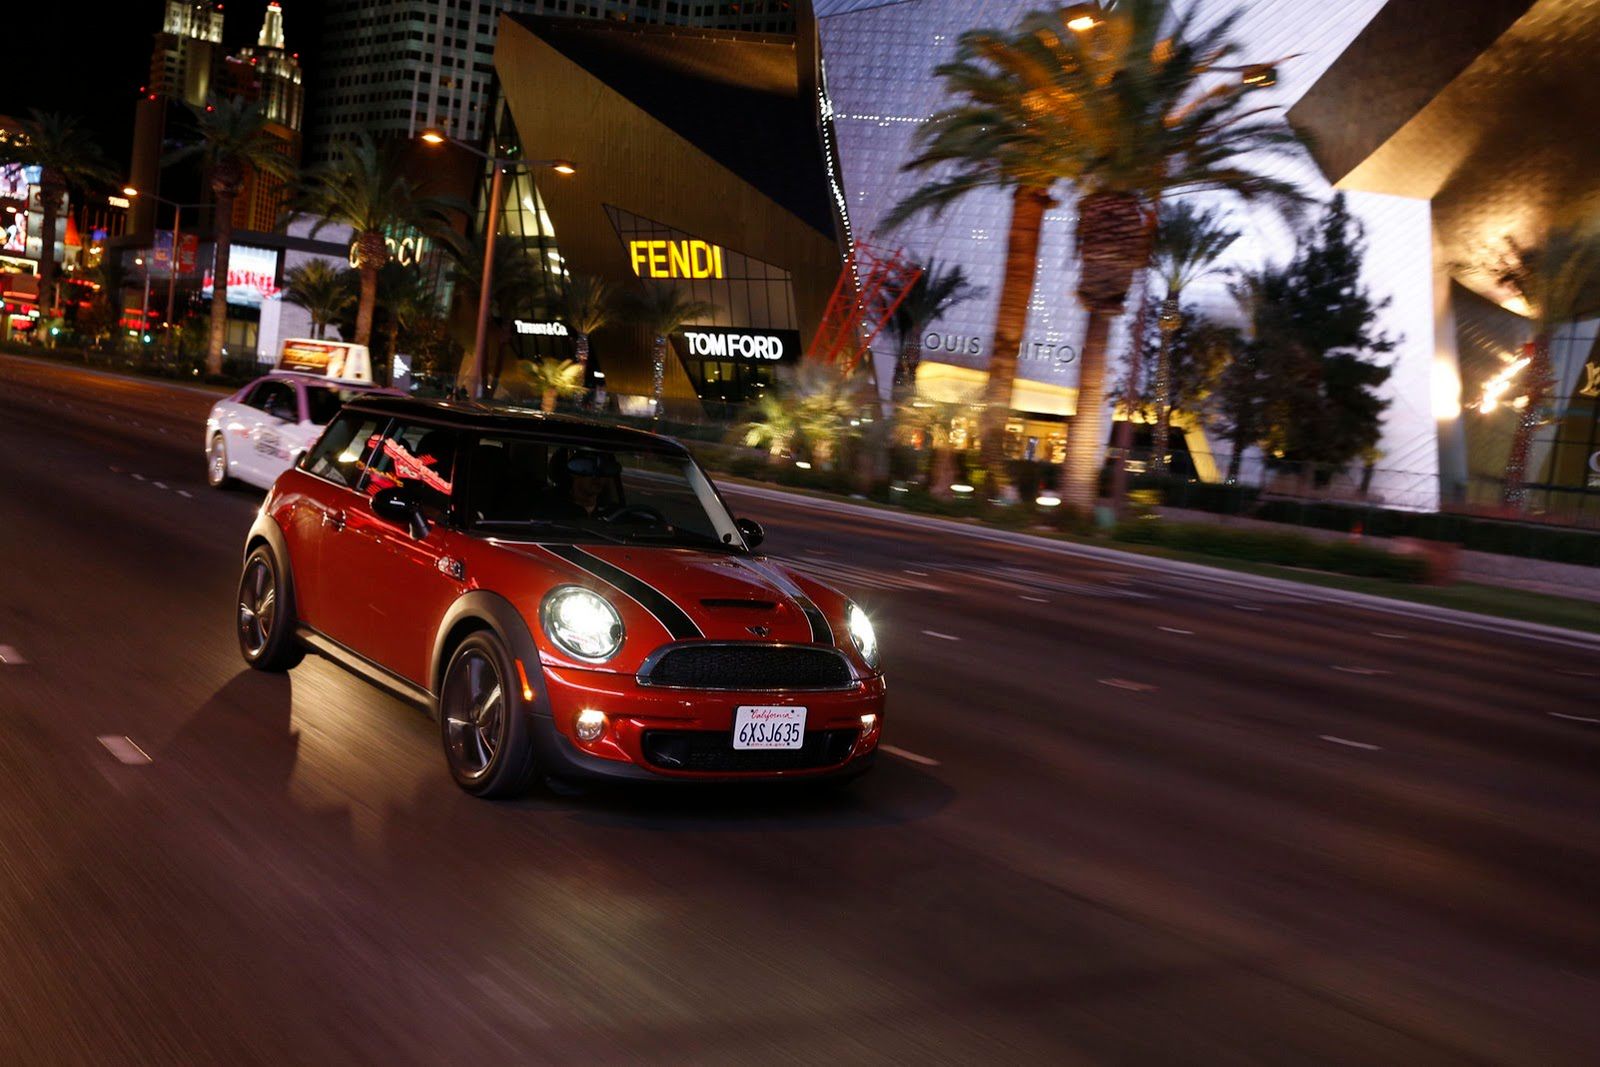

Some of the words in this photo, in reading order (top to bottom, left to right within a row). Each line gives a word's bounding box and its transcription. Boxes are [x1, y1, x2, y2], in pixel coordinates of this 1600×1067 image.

[629, 239, 723, 279] FENDI
[684, 332, 727, 356] TOM
[727, 334, 784, 360] FORD
[924, 332, 981, 354] OUIS
[752, 708, 792, 721] California
[739, 722, 800, 742] 6XSJ635
